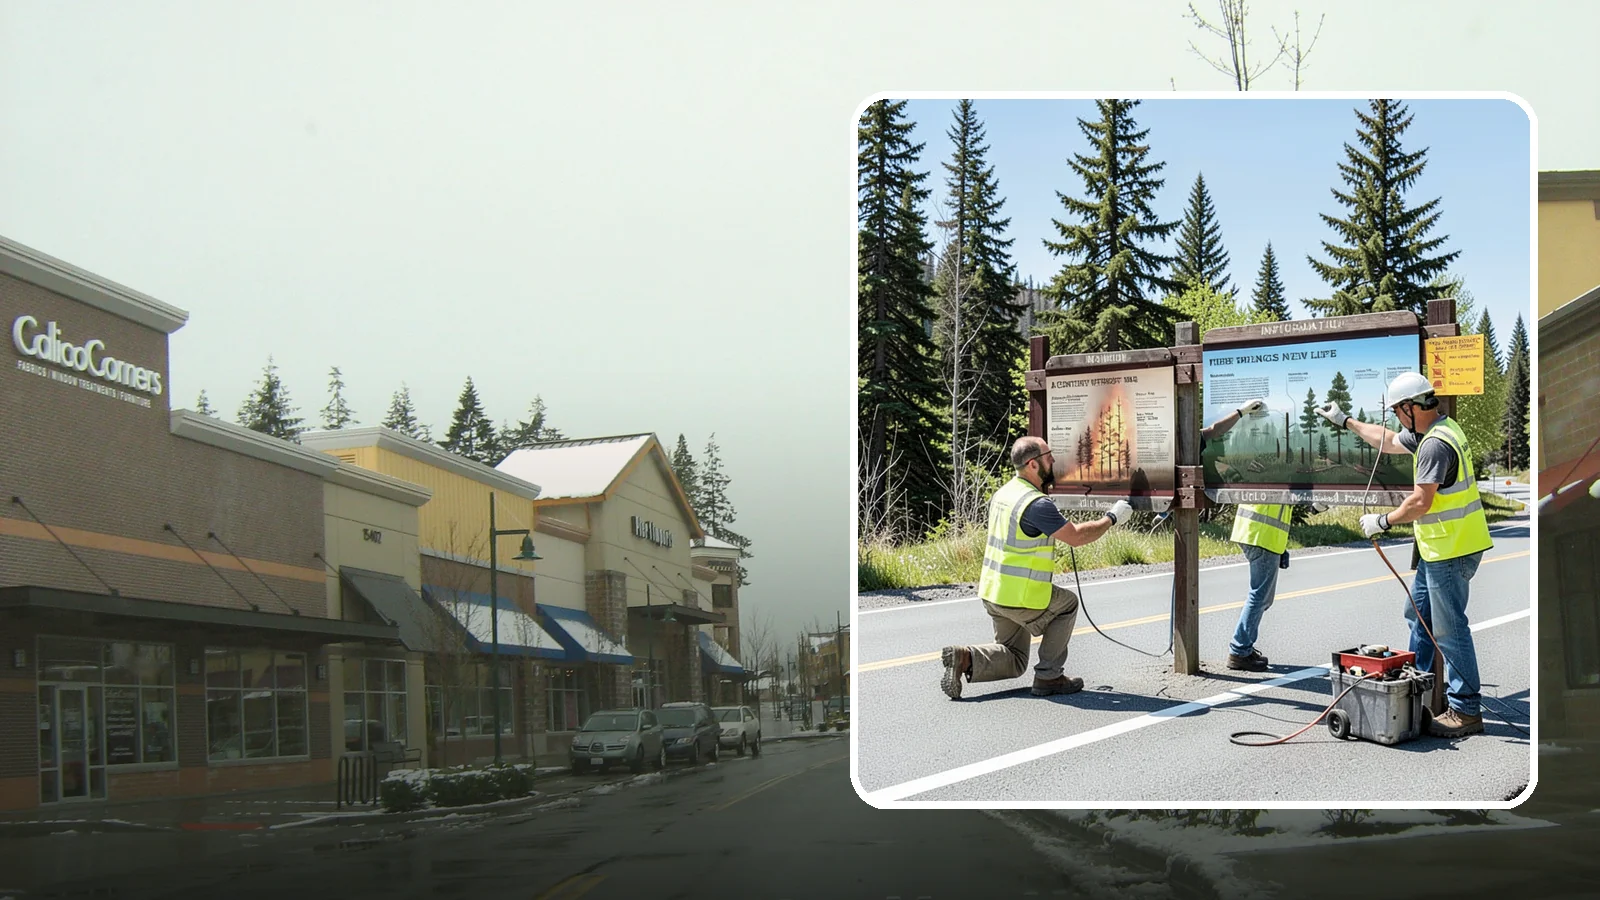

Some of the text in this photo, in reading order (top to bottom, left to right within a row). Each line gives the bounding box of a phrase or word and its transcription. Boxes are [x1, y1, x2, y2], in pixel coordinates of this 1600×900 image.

[17, 360, 47, 378] FABRICS
[51, 370, 78, 387] WINDOW
[78, 379, 117, 398] TREATMENTS
[120, 391, 151, 409] FURNITURE
